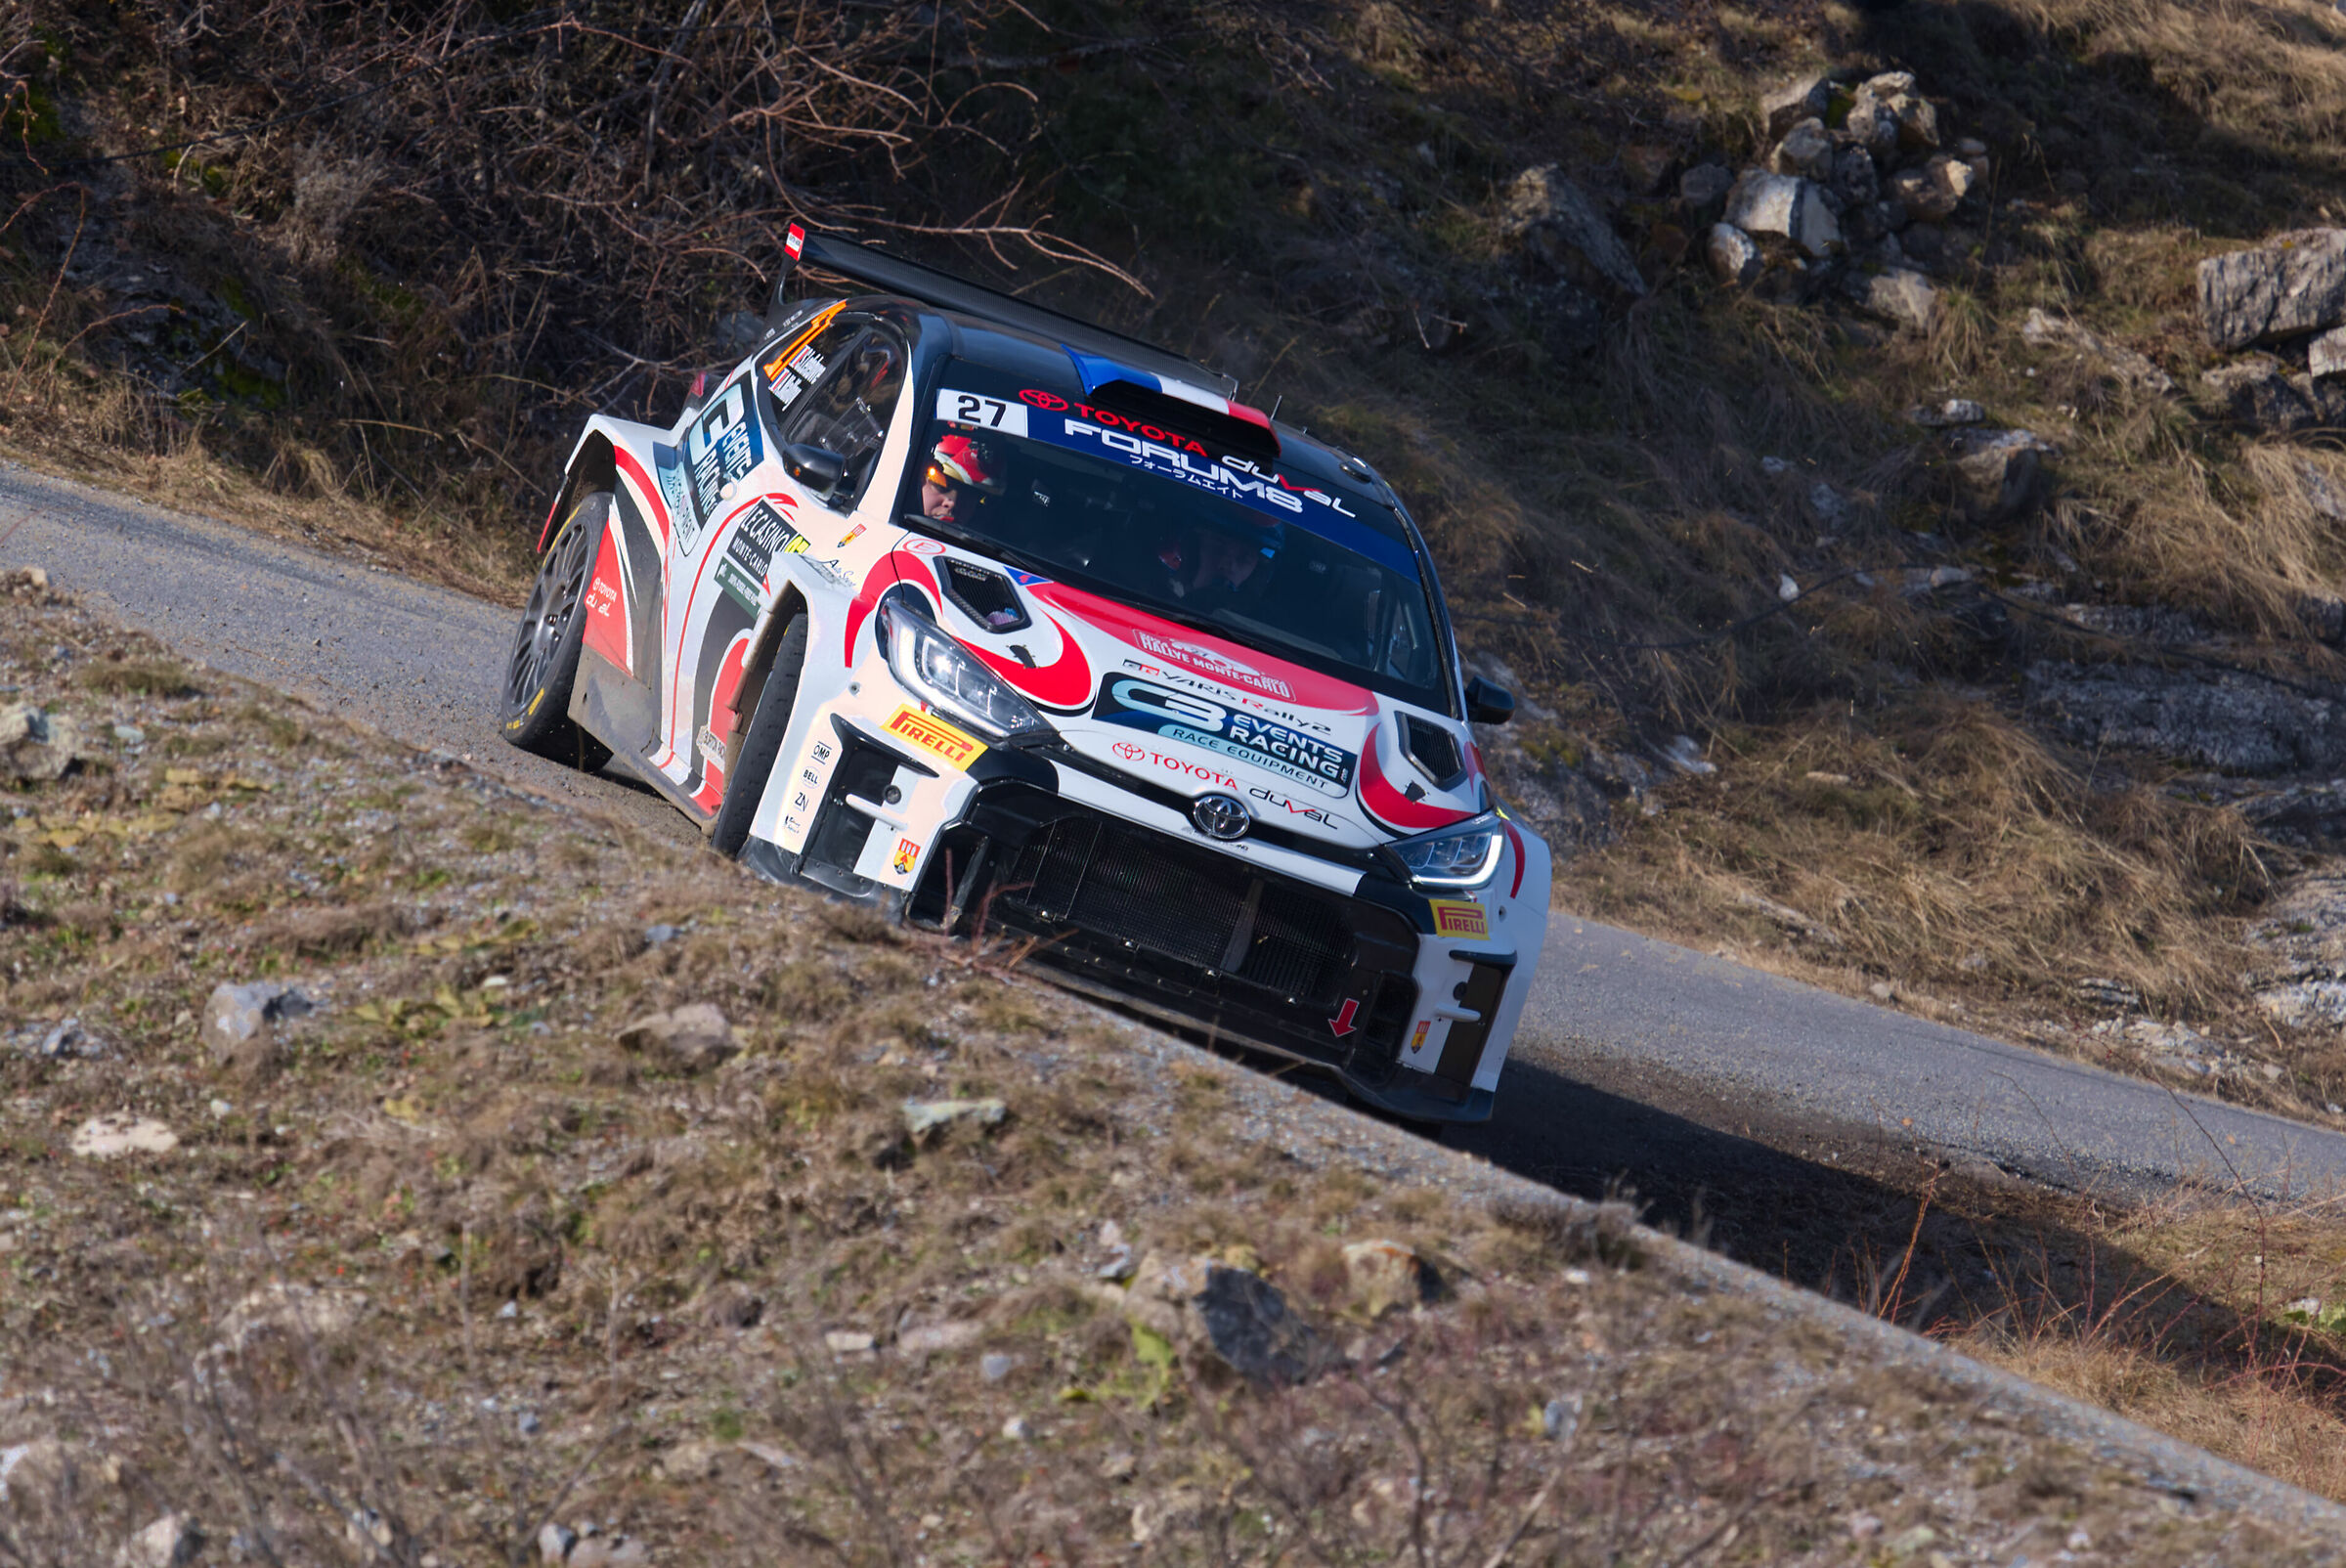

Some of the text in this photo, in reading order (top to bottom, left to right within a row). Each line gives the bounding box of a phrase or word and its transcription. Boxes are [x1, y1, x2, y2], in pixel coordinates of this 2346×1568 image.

[957, 394, 1007, 427] 27
[1074, 402, 1207, 457] TOYOTA
[722, 421, 753, 483] EVENTS
[1064, 418, 1303, 514] FORUM8
[1129, 454, 1243, 500] フォーラムエイト
[598, 582, 618, 603] TOYOTA
[1139, 632, 1191, 663] RALLYE
[1161, 672, 1237, 702] YARIS
[1240, 698, 1332, 736] Rally2
[812, 744, 831, 761] OMP
[889, 710, 975, 763] PIRELLI
[1172, 728, 1221, 749] RACE
[1227, 746, 1328, 789] EQUIPMENT
[1229, 724, 1340, 780] RACING
[1233, 713, 1344, 764] EVENTS
[803, 769, 818, 784] BELL
[1150, 751, 1238, 791] TOYOTA
[1437, 905, 1487, 935] PIRELLI
